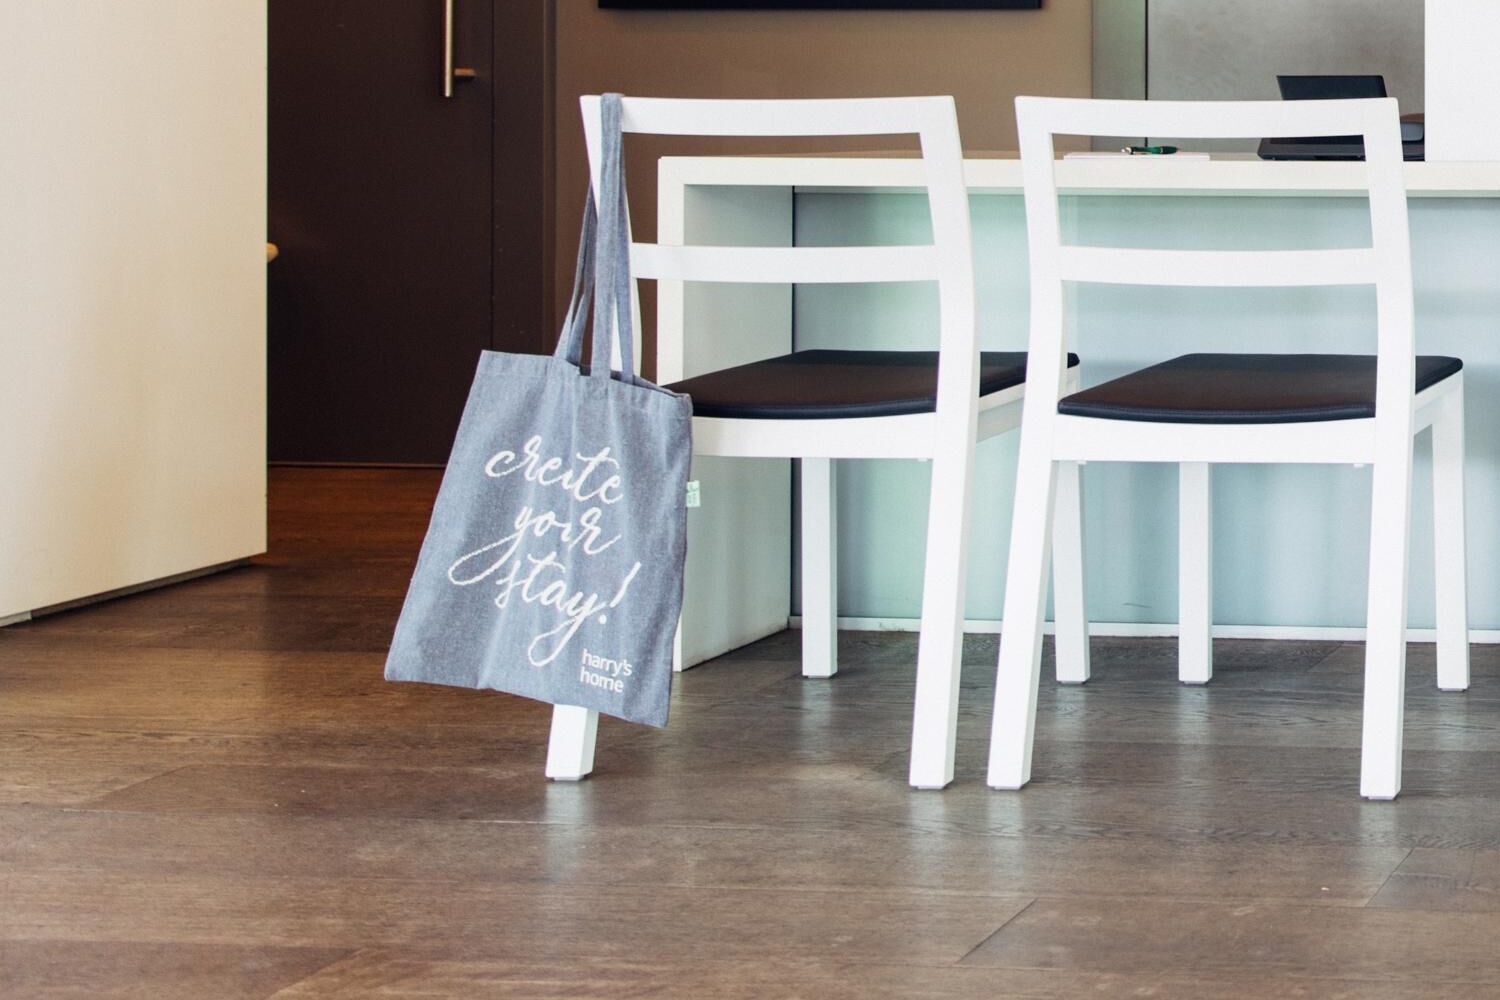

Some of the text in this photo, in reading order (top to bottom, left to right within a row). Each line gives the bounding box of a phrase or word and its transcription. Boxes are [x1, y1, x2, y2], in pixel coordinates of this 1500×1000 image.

[485, 435, 624, 504] create
[449, 506, 622, 585] your
[495, 551, 641, 667] stay!
[580, 666, 624, 693] home
[582, 648, 632, 677] harry's
